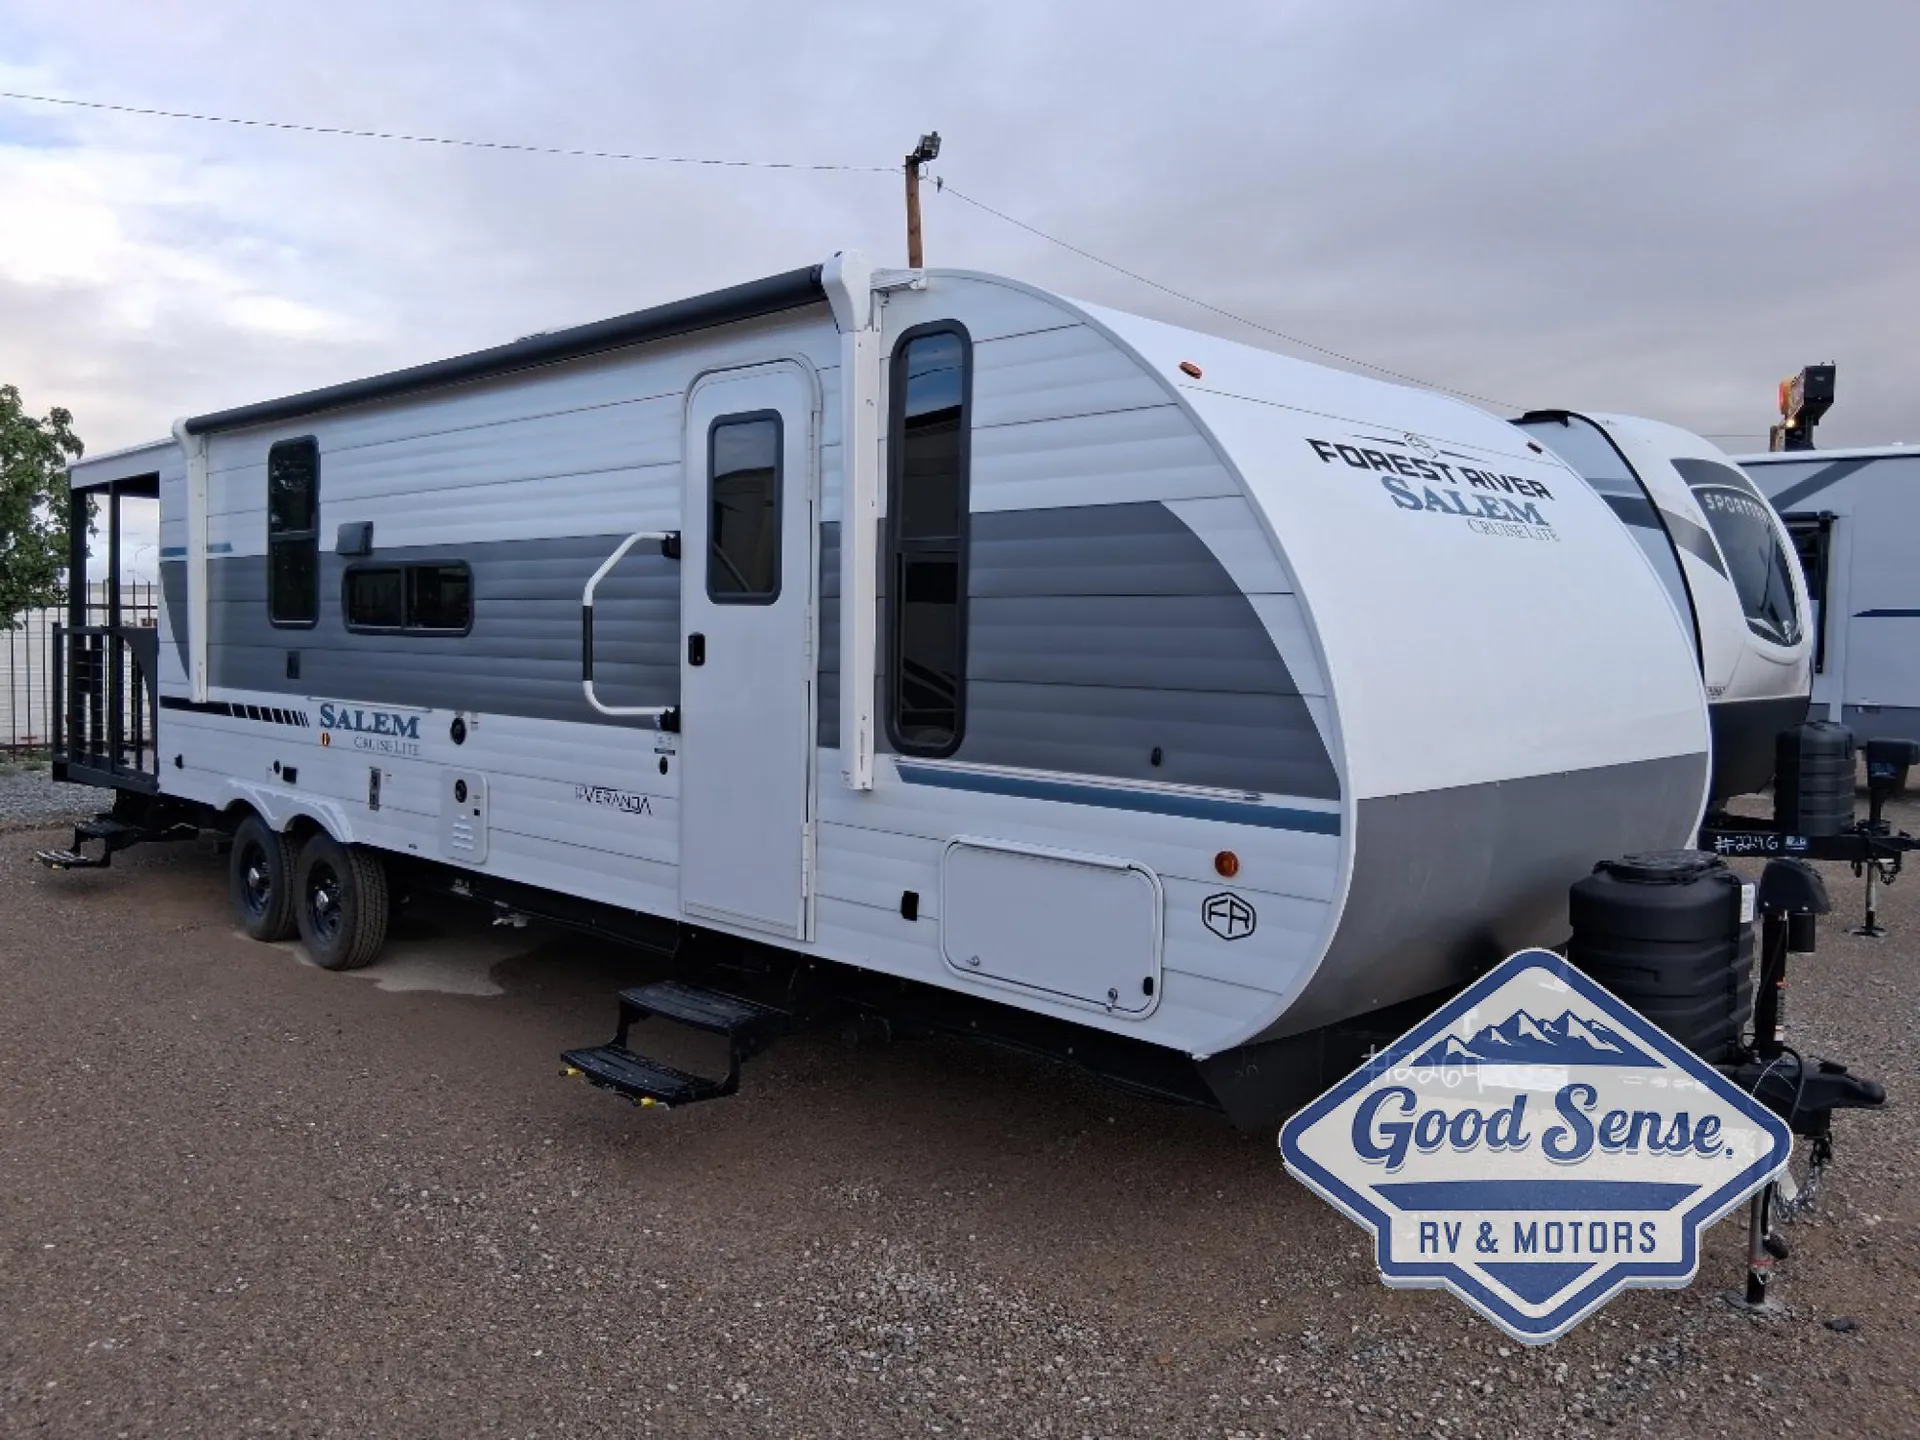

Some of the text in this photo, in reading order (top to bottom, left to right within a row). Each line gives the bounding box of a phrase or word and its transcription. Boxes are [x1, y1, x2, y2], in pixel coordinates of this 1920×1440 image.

[1305, 438, 1556, 501] FOREST RIVER
[1380, 475, 1550, 527] SALEM
[320, 702, 421, 739] SALEM
